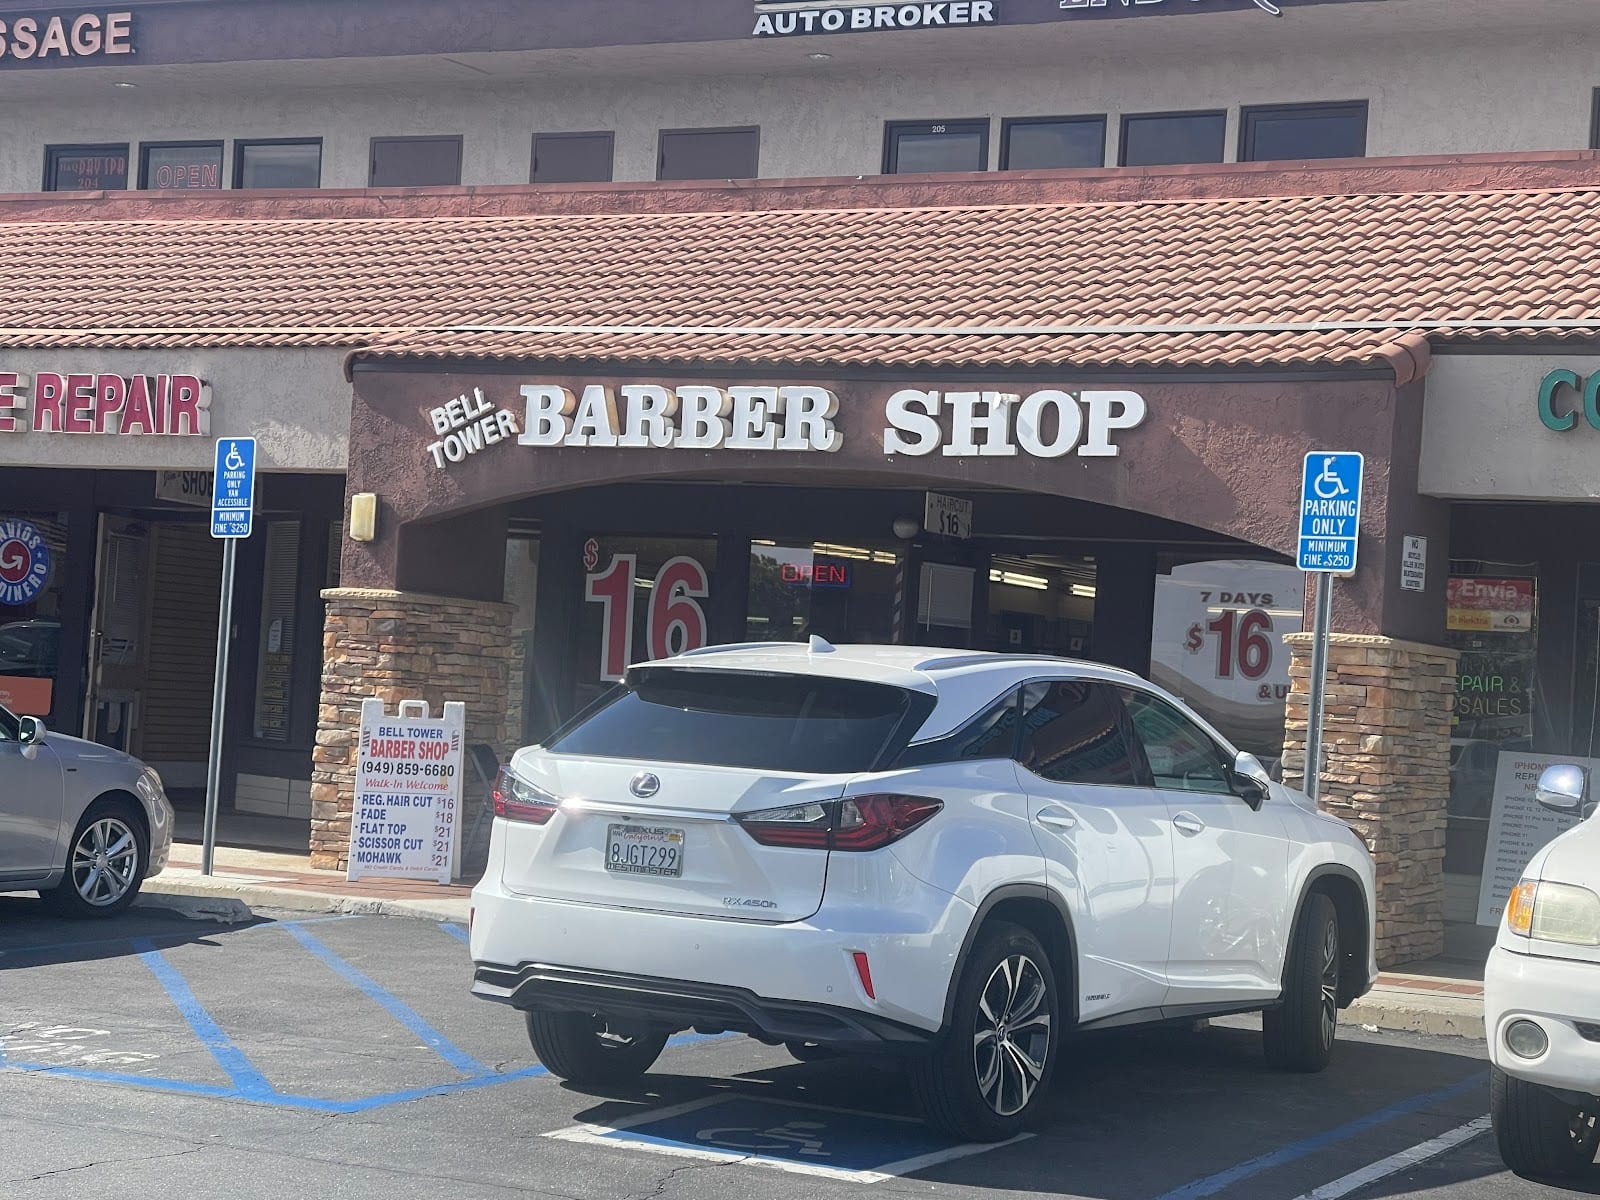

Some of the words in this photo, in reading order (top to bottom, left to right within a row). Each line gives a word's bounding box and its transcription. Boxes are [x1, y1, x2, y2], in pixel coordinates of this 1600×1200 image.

[752, 9, 845, 35] AUTO
[850, 0, 994, 30] BROKER
[0, 12, 132, 60] SAGE
[932, 125, 946, 133] 205
[157, 164, 217, 189] OPEN
[33, 372, 207, 435] REPAIR
[430, 387, 495, 435] BELL
[518, 384, 843, 452] BARBER
[883, 389, 1147, 458] SHOP
[426, 408, 519, 469] TOWER
[223, 471, 246, 480] PARKING
[226, 480, 241, 489] ONLY
[228, 489, 239, 497] VAN
[217, 498, 249, 507] ACCESSIBLE
[937, 496, 969, 512] HAIRCUT
[1304, 499, 1356, 517] PARKING
[219, 511, 245, 522] MINIMUM
[939, 510, 959, 535] $16
[214, 523, 228, 534] FINE
[230, 523, 248, 534] $250
[1312, 518, 1346, 535] ONLY
[1308, 540, 1347, 553] MINIMUM
[1303, 554, 1323, 566] FINE
[1327, 554, 1350, 567] $250
[782, 564, 846, 583] OPEN
[1200, 591, 1212, 603] 7
[1219, 591, 1274, 605] DAYS
[1274, 684, 1291, 700] U
[1456, 675, 1504, 693] PAIR
[1508, 676, 1522, 694] &
[1458, 696, 1522, 716] SALES
[379, 727, 404, 738] BELL
[407, 728, 443, 739] TOWER
[370, 738, 415, 759] BARBER
[418, 741, 450, 761] SHOP
[362, 761, 394, 775] (949)
[396, 763, 455, 777] 859-6680
[365, 778, 402, 789] Walk-In
[405, 779, 449, 791] Welcome
[362, 794, 385, 806] REG.
[386, 795, 410, 807] HAIR
[413, 796, 433, 808] CUT
[437, 797, 454, 810] $16
[360, 808, 387, 820] FADE
[435, 811, 453, 824] $18
[359, 822, 385, 835] FLAT
[387, 823, 407, 835] TOP
[434, 825, 451, 838] $21
[358, 837, 401, 850] SCISSOR
[403, 838, 424, 850] CUT
[432, 839, 449, 852] $21
[357, 851, 402, 864] MOHAWK
[431, 854, 448, 867] $21
[611, 842, 677, 868] 8JGT299
